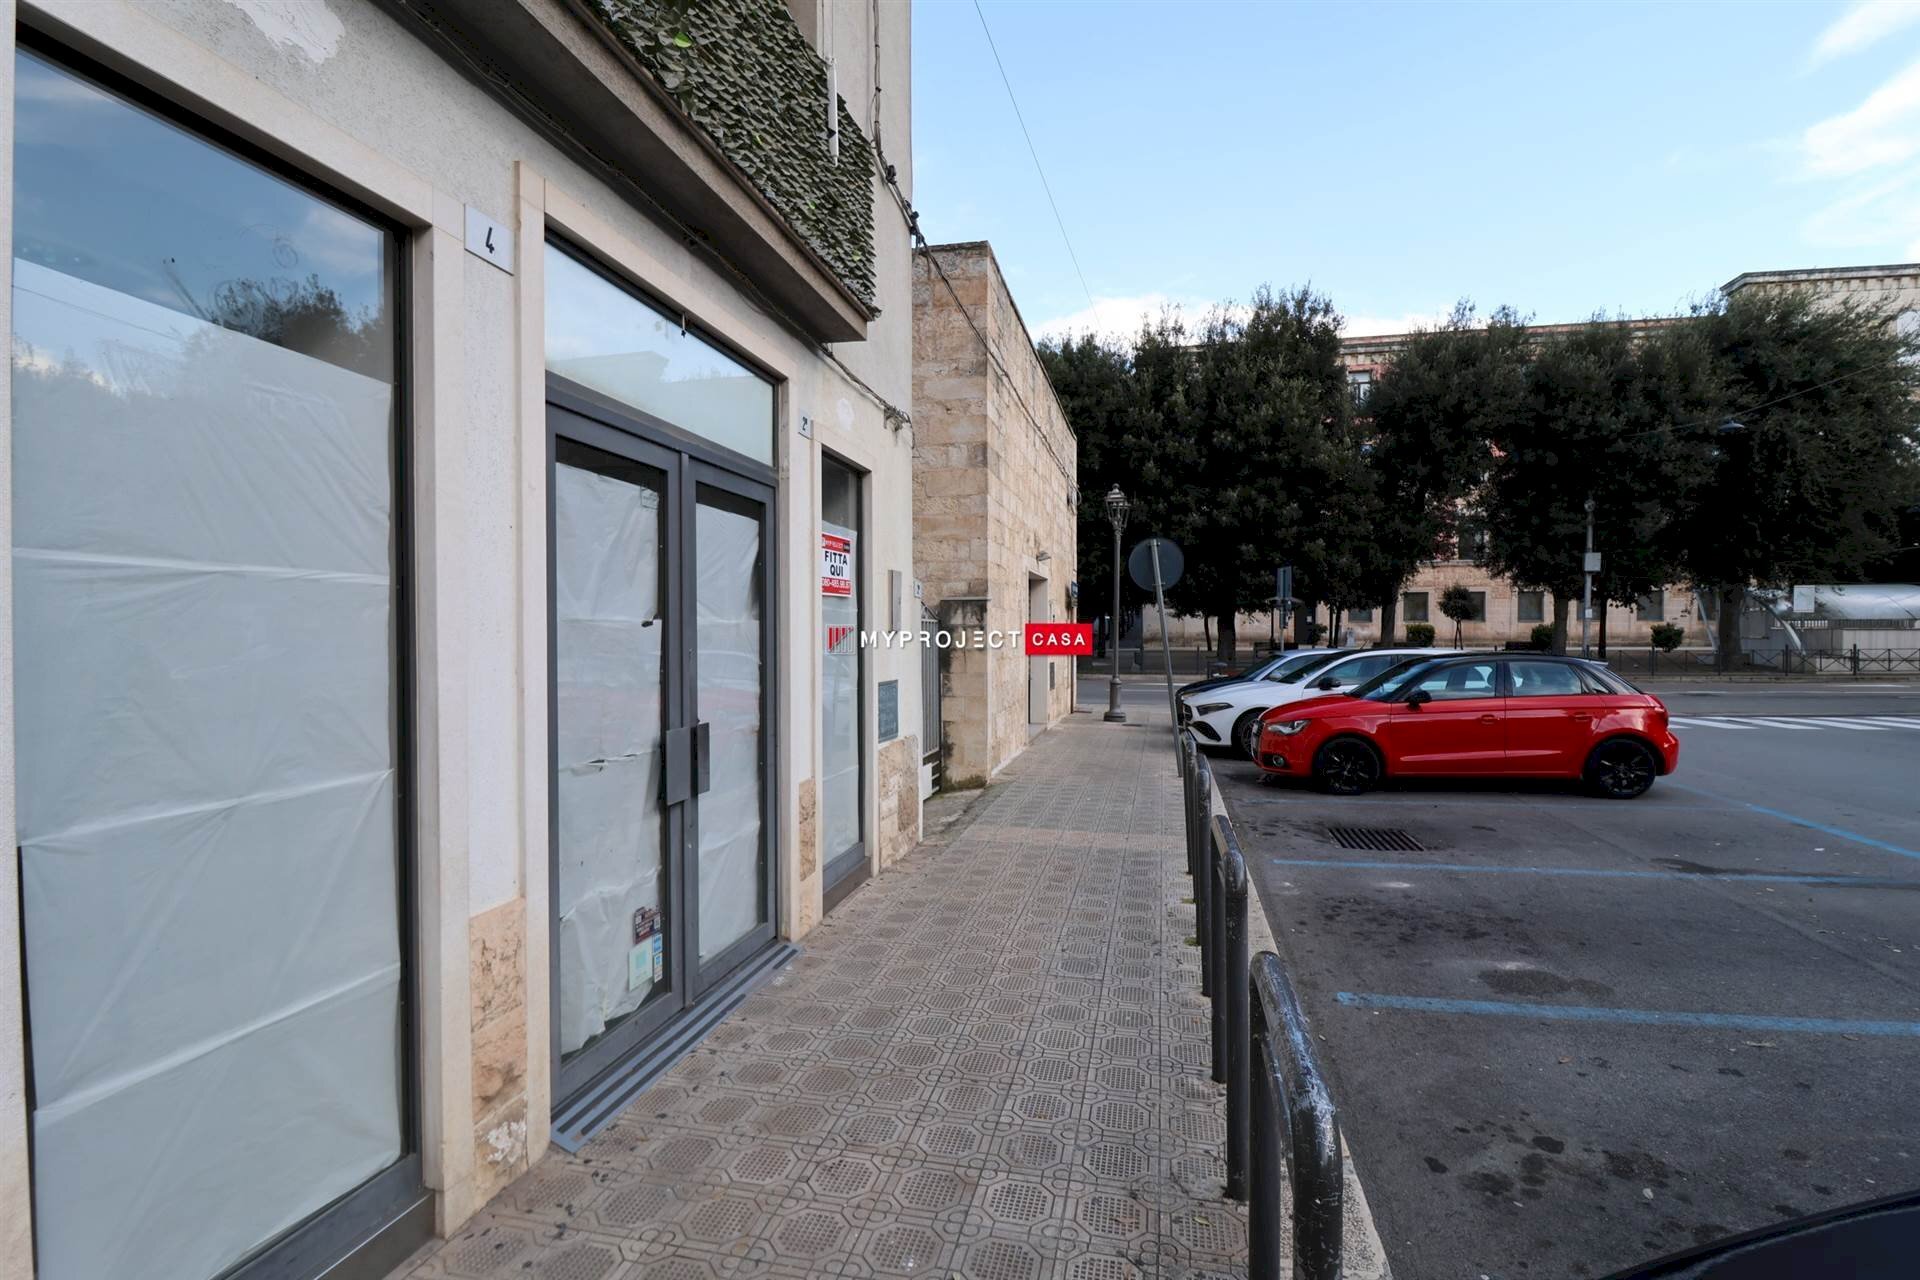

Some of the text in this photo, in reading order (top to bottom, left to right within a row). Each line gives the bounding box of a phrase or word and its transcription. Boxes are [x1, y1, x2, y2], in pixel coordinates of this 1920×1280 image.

[485, 226, 495, 255] 4
[824, 550, 848, 566] FITTA
[829, 564, 844, 578] QUI
